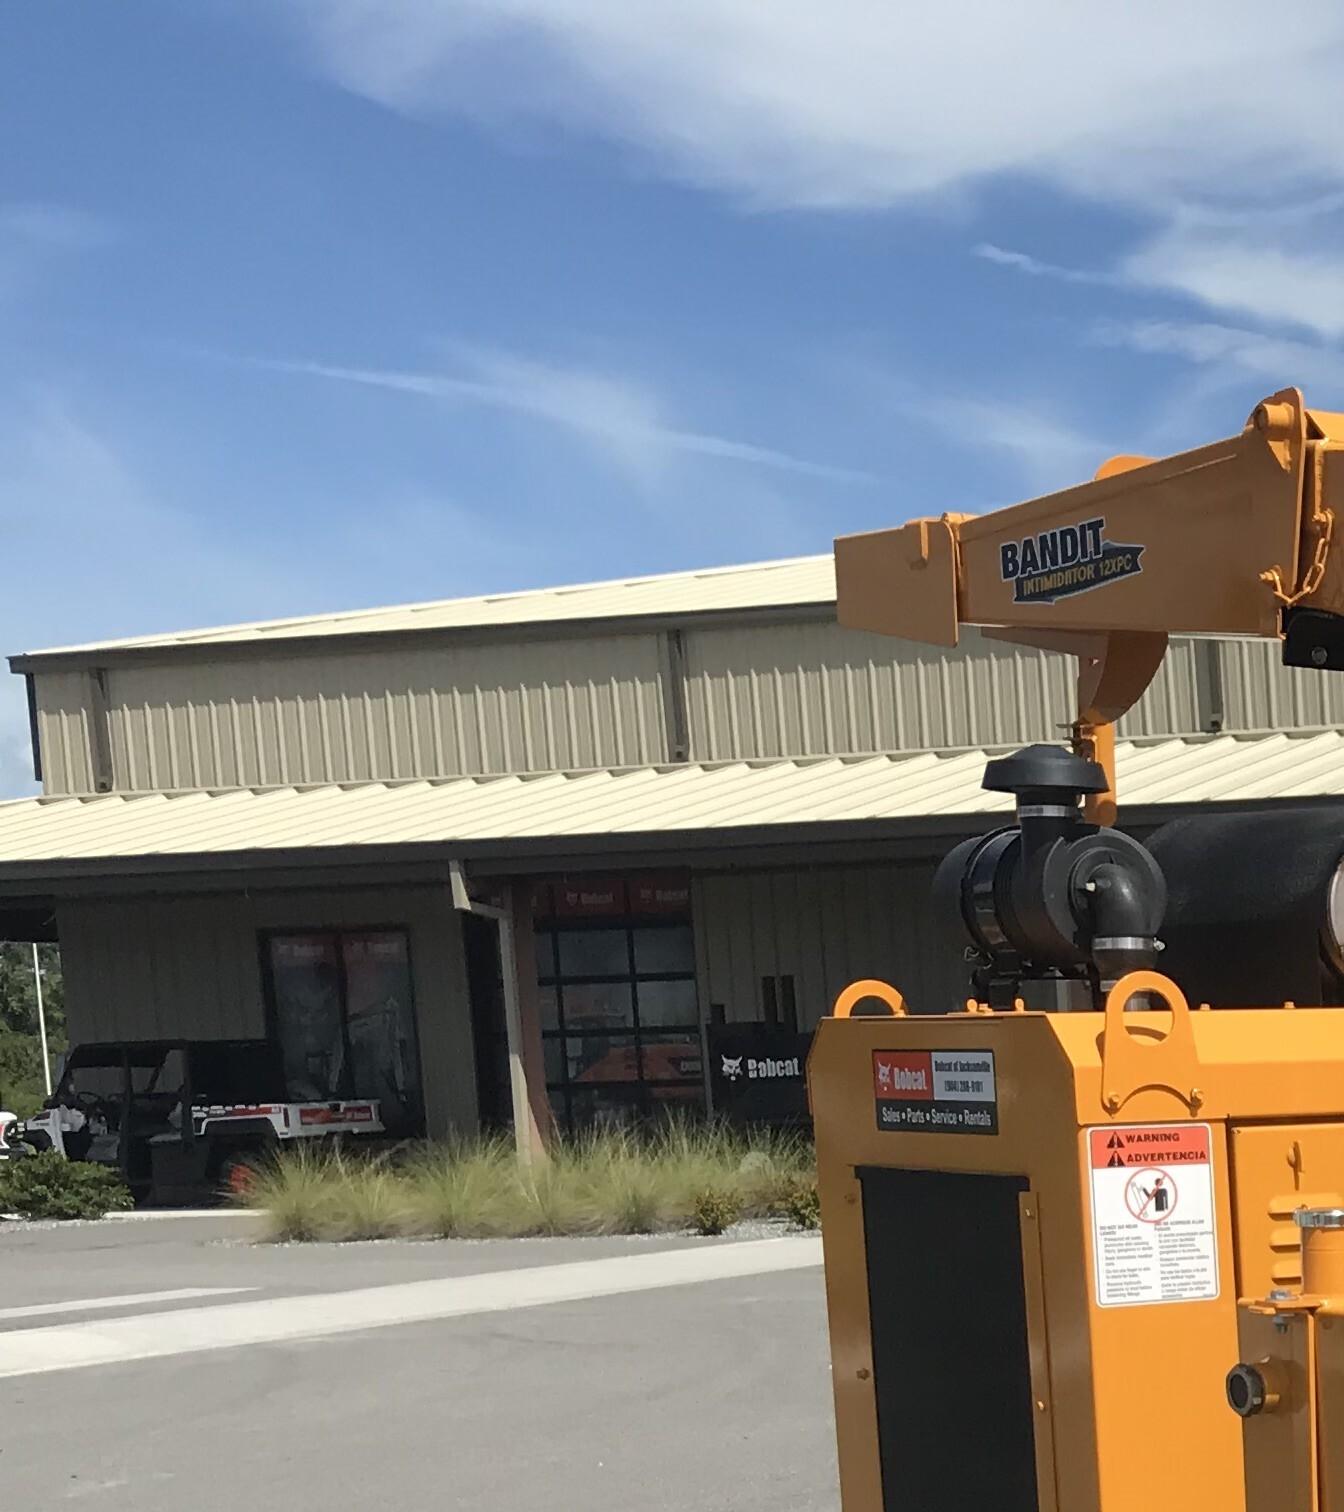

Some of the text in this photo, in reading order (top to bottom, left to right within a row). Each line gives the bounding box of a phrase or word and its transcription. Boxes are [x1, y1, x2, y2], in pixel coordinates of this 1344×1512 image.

[1001, 519, 1104, 579] BANDIT
[1100, 555, 1132, 576] 12XPC
[747, 1058, 800, 1078] Bobcat
[894, 1067, 927, 1090] Bobcat
[882, 1106, 992, 1126] Sales Parts Service Rentals
[1126, 1133, 1180, 1143] WARNING
[1126, 1151, 1206, 1163] ADVERTENCIA
